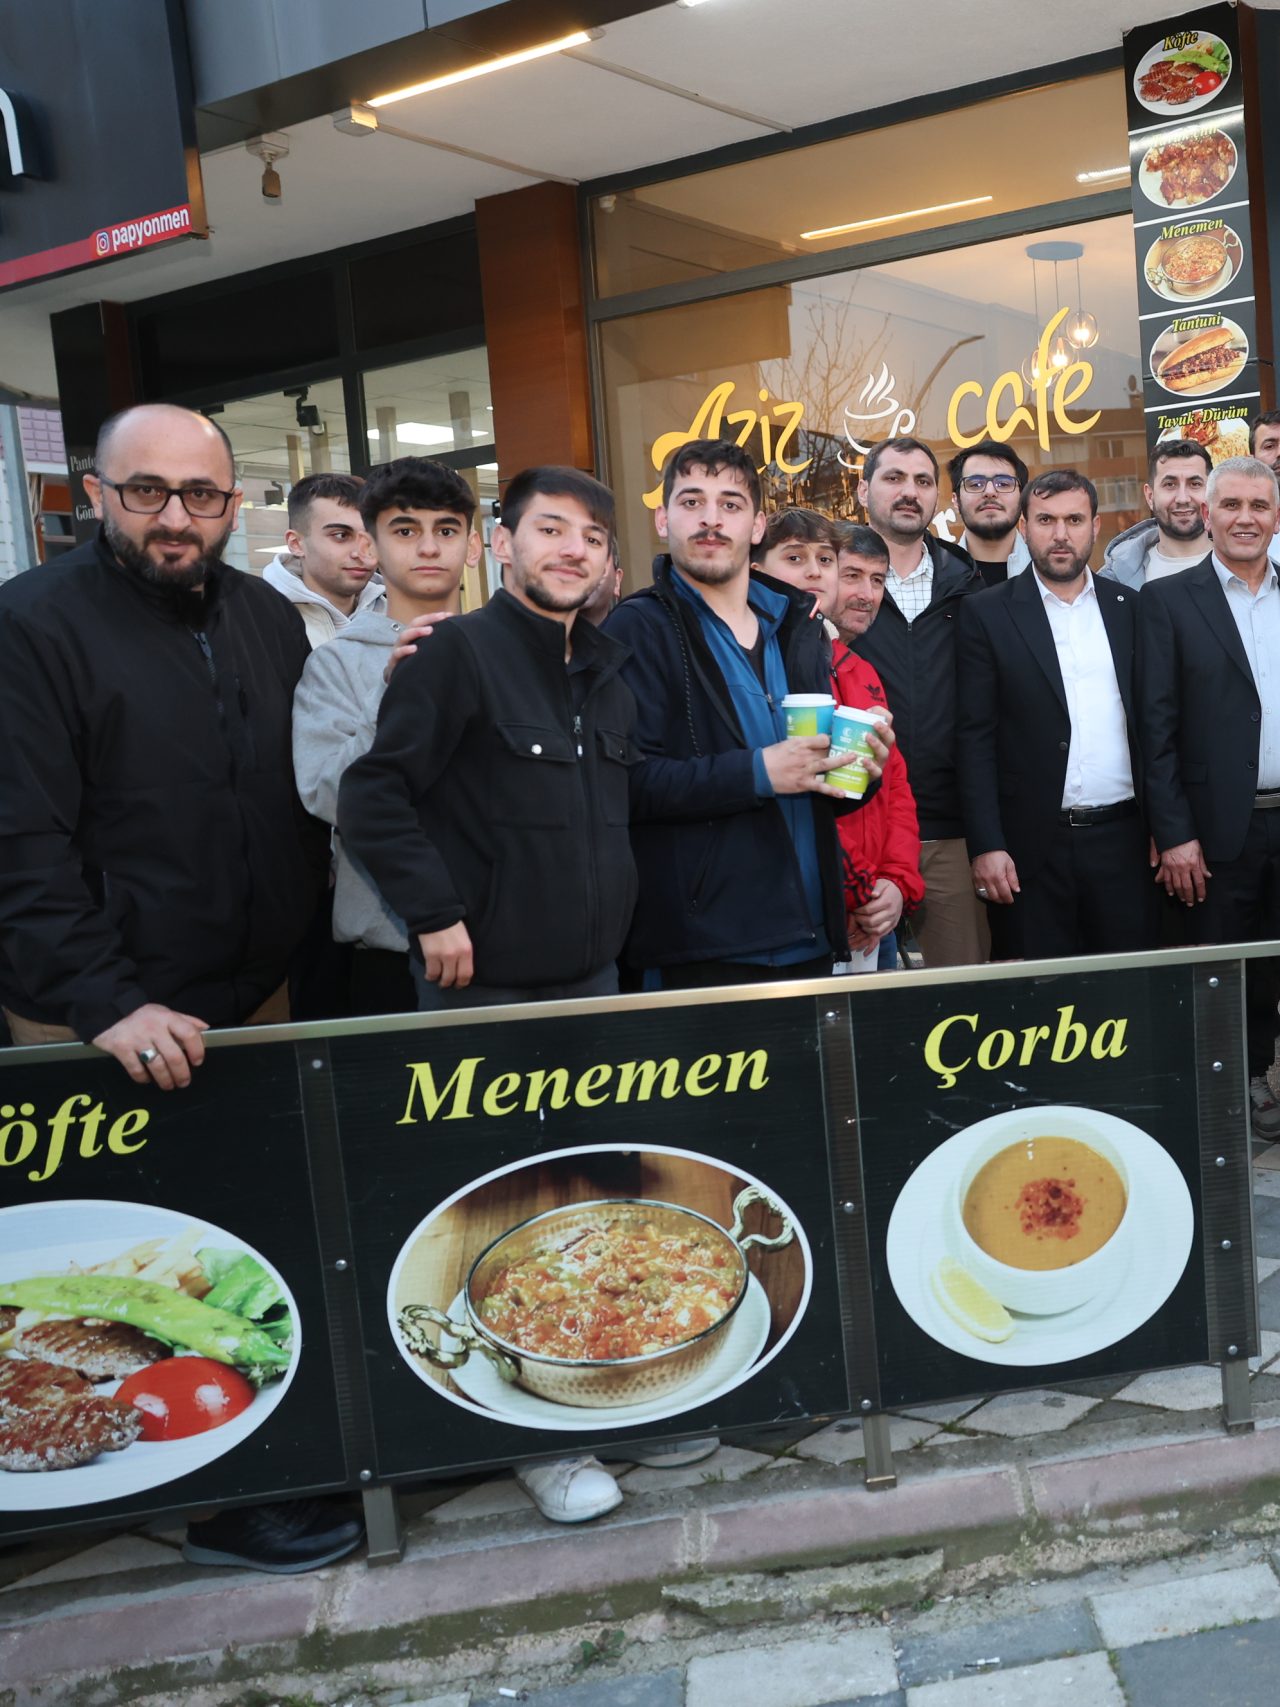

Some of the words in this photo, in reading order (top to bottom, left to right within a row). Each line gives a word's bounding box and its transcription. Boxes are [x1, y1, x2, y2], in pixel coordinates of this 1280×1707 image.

[1163, 32, 1198, 51] Köfte
[112, 208, 189, 250] papyonmen
[1160, 219, 1224, 240] Menemen
[1172, 312, 1222, 332] Tantuni
[946, 307, 1102, 452] cafe
[1157, 413, 1194, 429] Tavuk
[1201, 406, 1248, 423] Dürüm
[923, 1005, 1129, 1089] Çorba
[396, 1048, 769, 1125] Menemen
[0, 1094, 150, 1181] öfte
